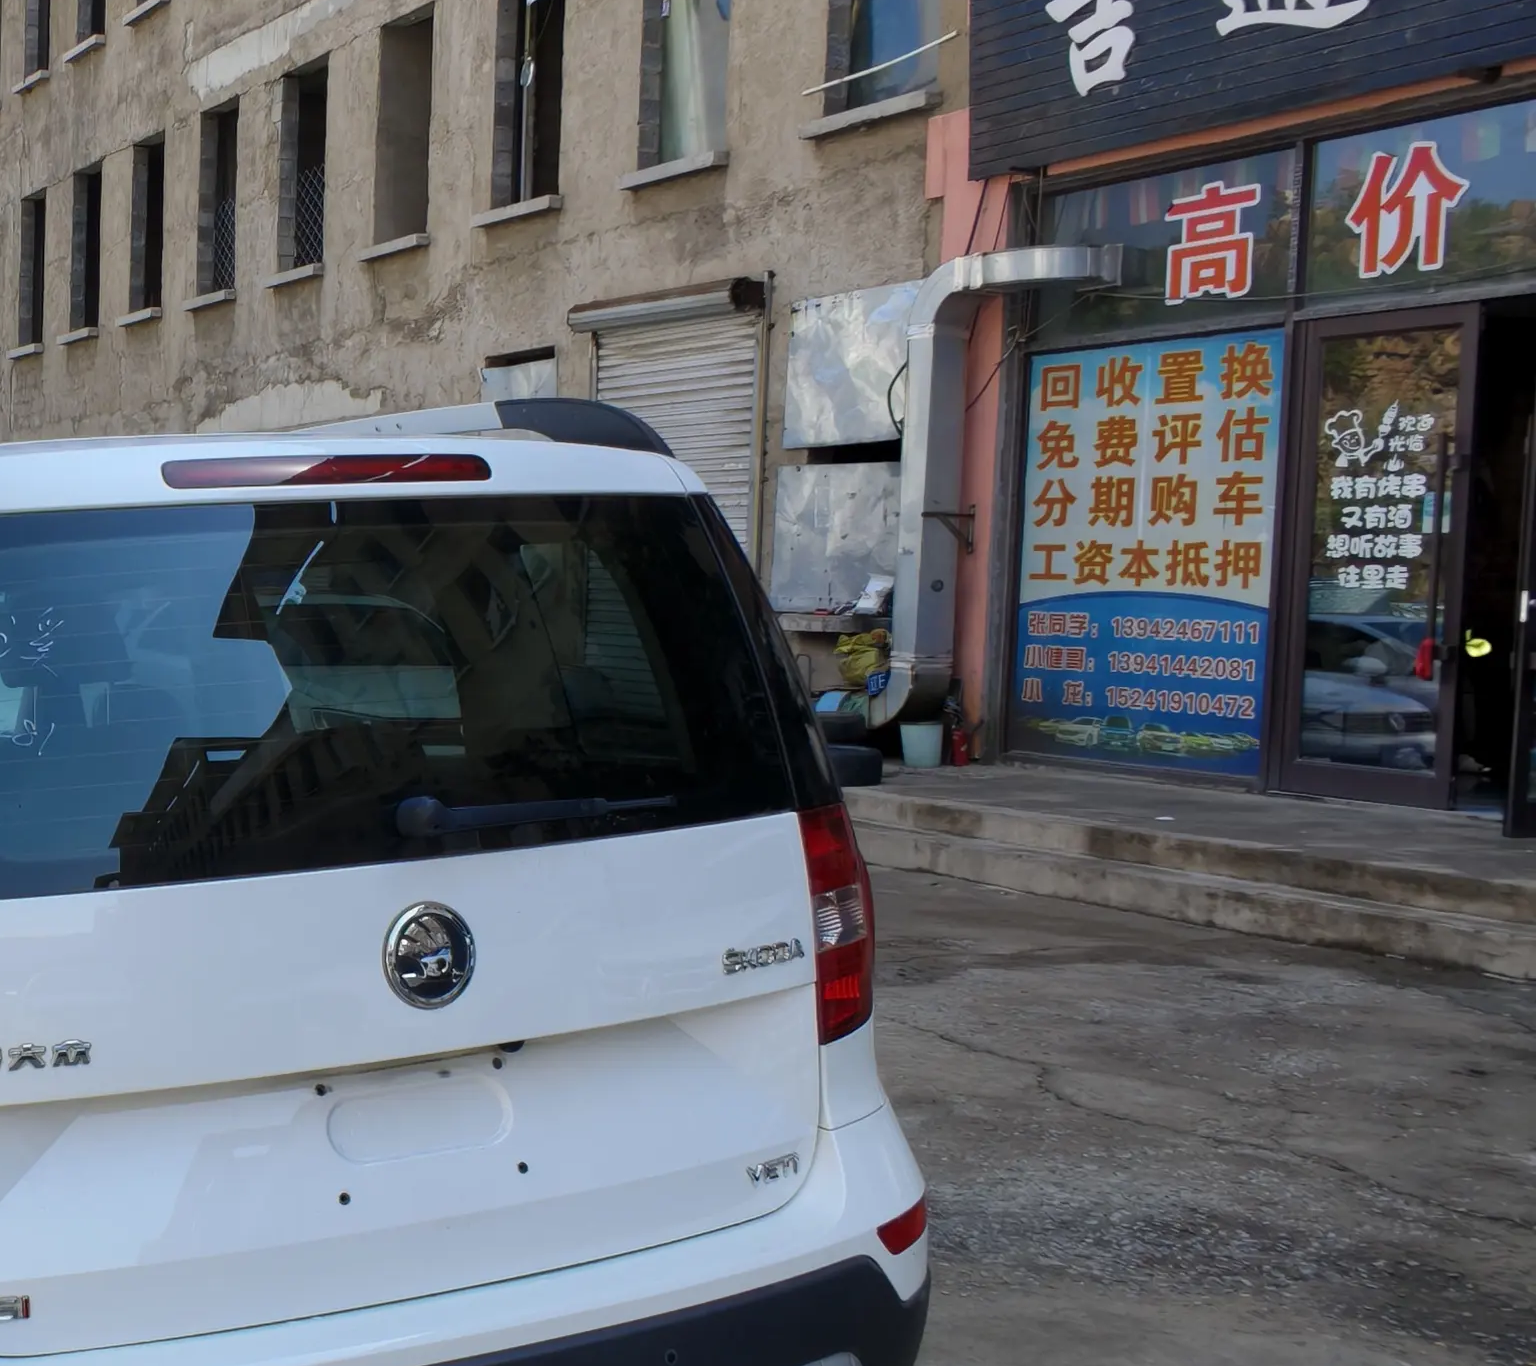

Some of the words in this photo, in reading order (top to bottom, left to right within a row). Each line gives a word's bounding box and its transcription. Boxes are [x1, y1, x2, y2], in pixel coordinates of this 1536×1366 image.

[1039, 342, 1275, 412] 回收置换
[1035, 406, 1271, 471] 免费评估
[1032, 471, 1265, 528] 分期购车
[1330, 473, 1427, 500] 我有烤串
[1341, 504, 1413, 529] 又有酒
[1325, 534, 1423, 559] 想听故事
[1028, 539, 1263, 589] 工资本抵押
[1338, 565, 1409, 590] 往里走
[1111, 616, 1260, 644] 13942467111
[1108, 651, 1256, 681] 13941442081
[1105, 686, 1255, 720] 15241910472
[746, 1152, 800, 1188] YETI
